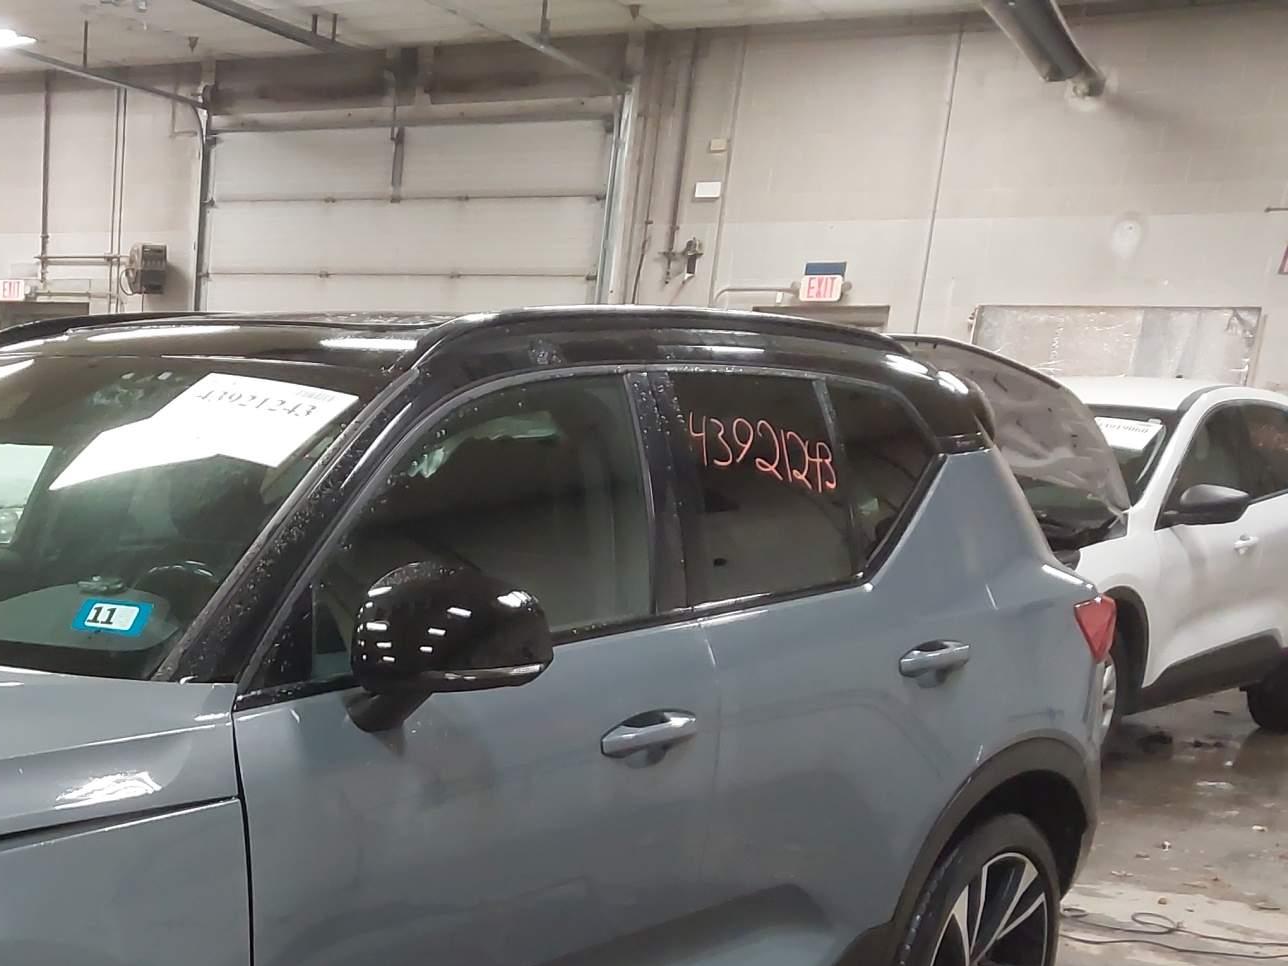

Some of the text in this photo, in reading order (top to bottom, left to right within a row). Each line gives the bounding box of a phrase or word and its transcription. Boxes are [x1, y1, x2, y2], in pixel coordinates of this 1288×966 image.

[2, 280, 20, 298] EXIT
[807, 276, 837, 299] EXIT
[689, 411, 837, 493] 43921243
[87, 606, 117, 625] 11
